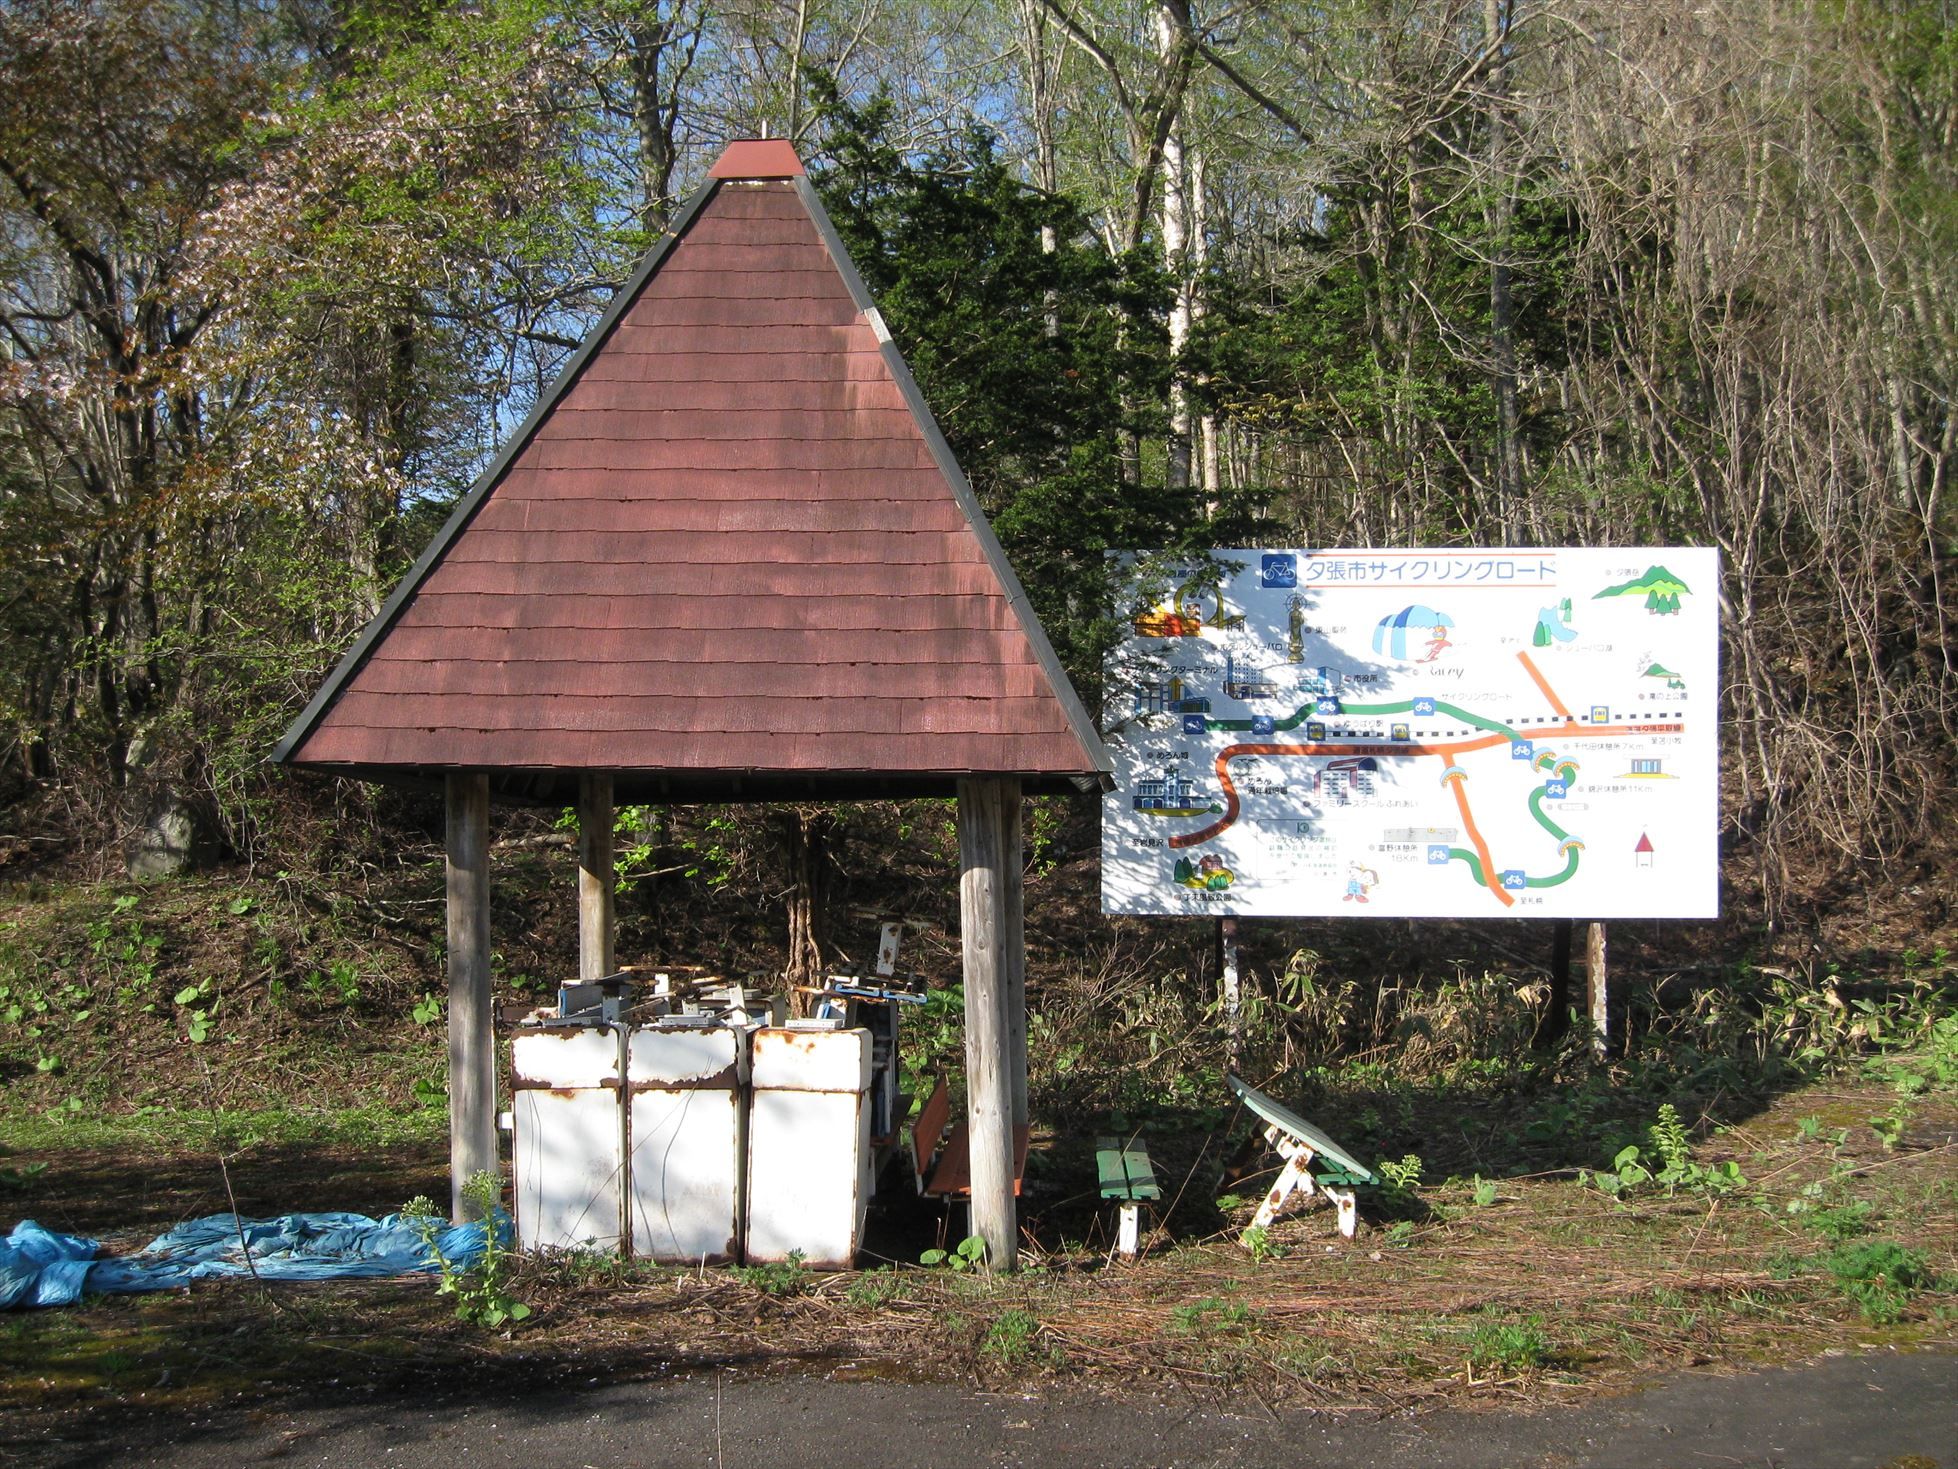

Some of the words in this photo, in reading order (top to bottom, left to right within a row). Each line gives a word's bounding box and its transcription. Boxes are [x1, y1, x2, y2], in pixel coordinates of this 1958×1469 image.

[1306, 560, 1556, 581] 夕張市サイクリングロード
[1354, 674, 1378, 682] 市役所
